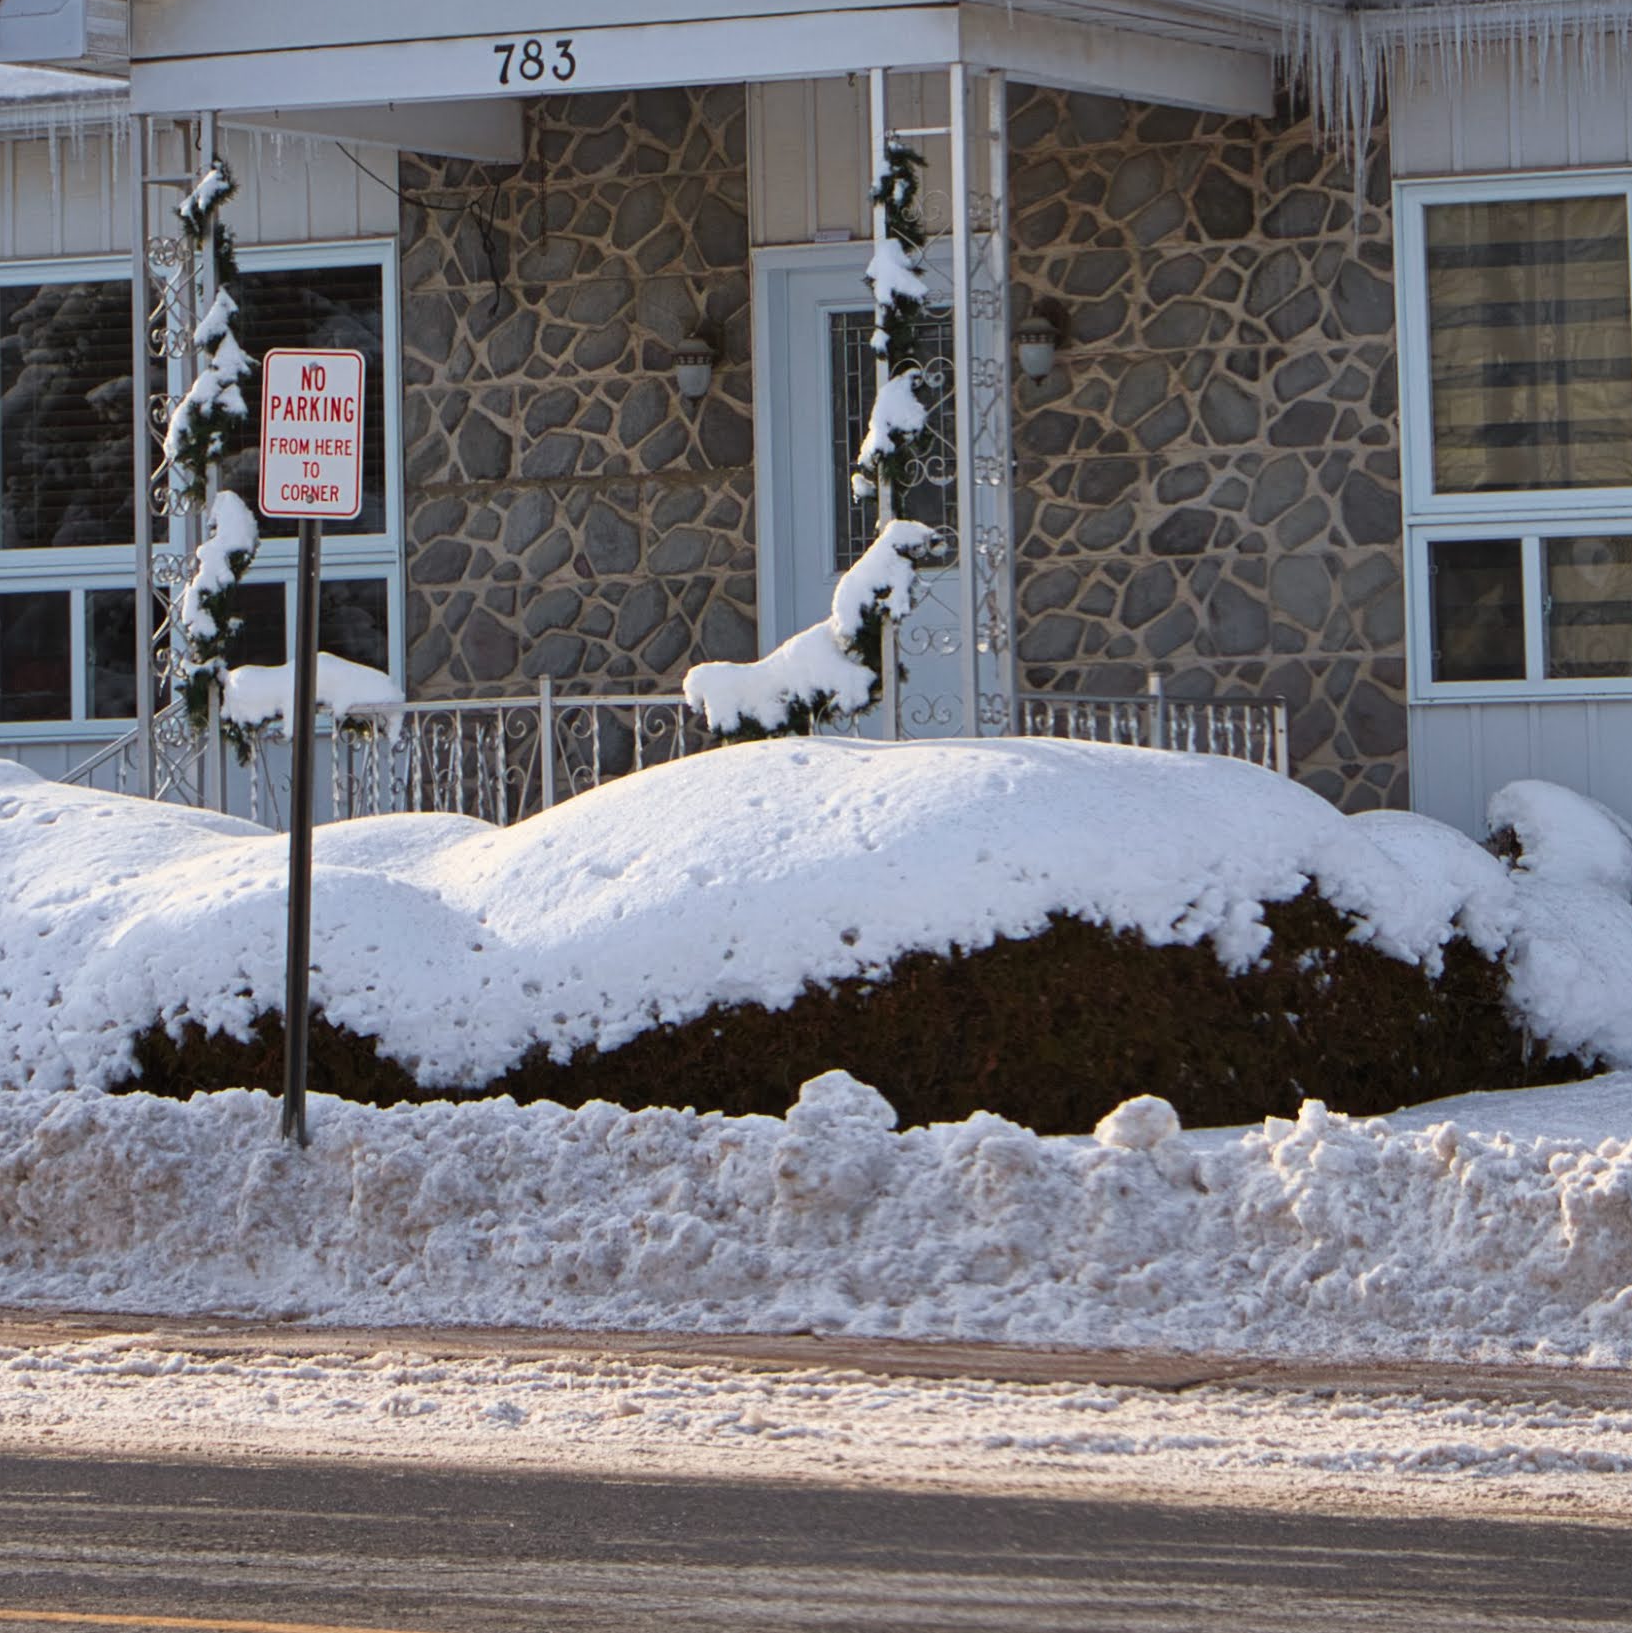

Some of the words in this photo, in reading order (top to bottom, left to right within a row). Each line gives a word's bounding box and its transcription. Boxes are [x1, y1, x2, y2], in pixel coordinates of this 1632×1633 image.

[493, 39, 576, 85] 783
[300, 365, 326, 392] NO
[270, 396, 355, 423] PARKING
[269, 437, 310, 456] FROM
[315, 439, 353, 456] HERE
[302, 461, 320, 479] TO
[280, 483, 339, 502] CORNER
